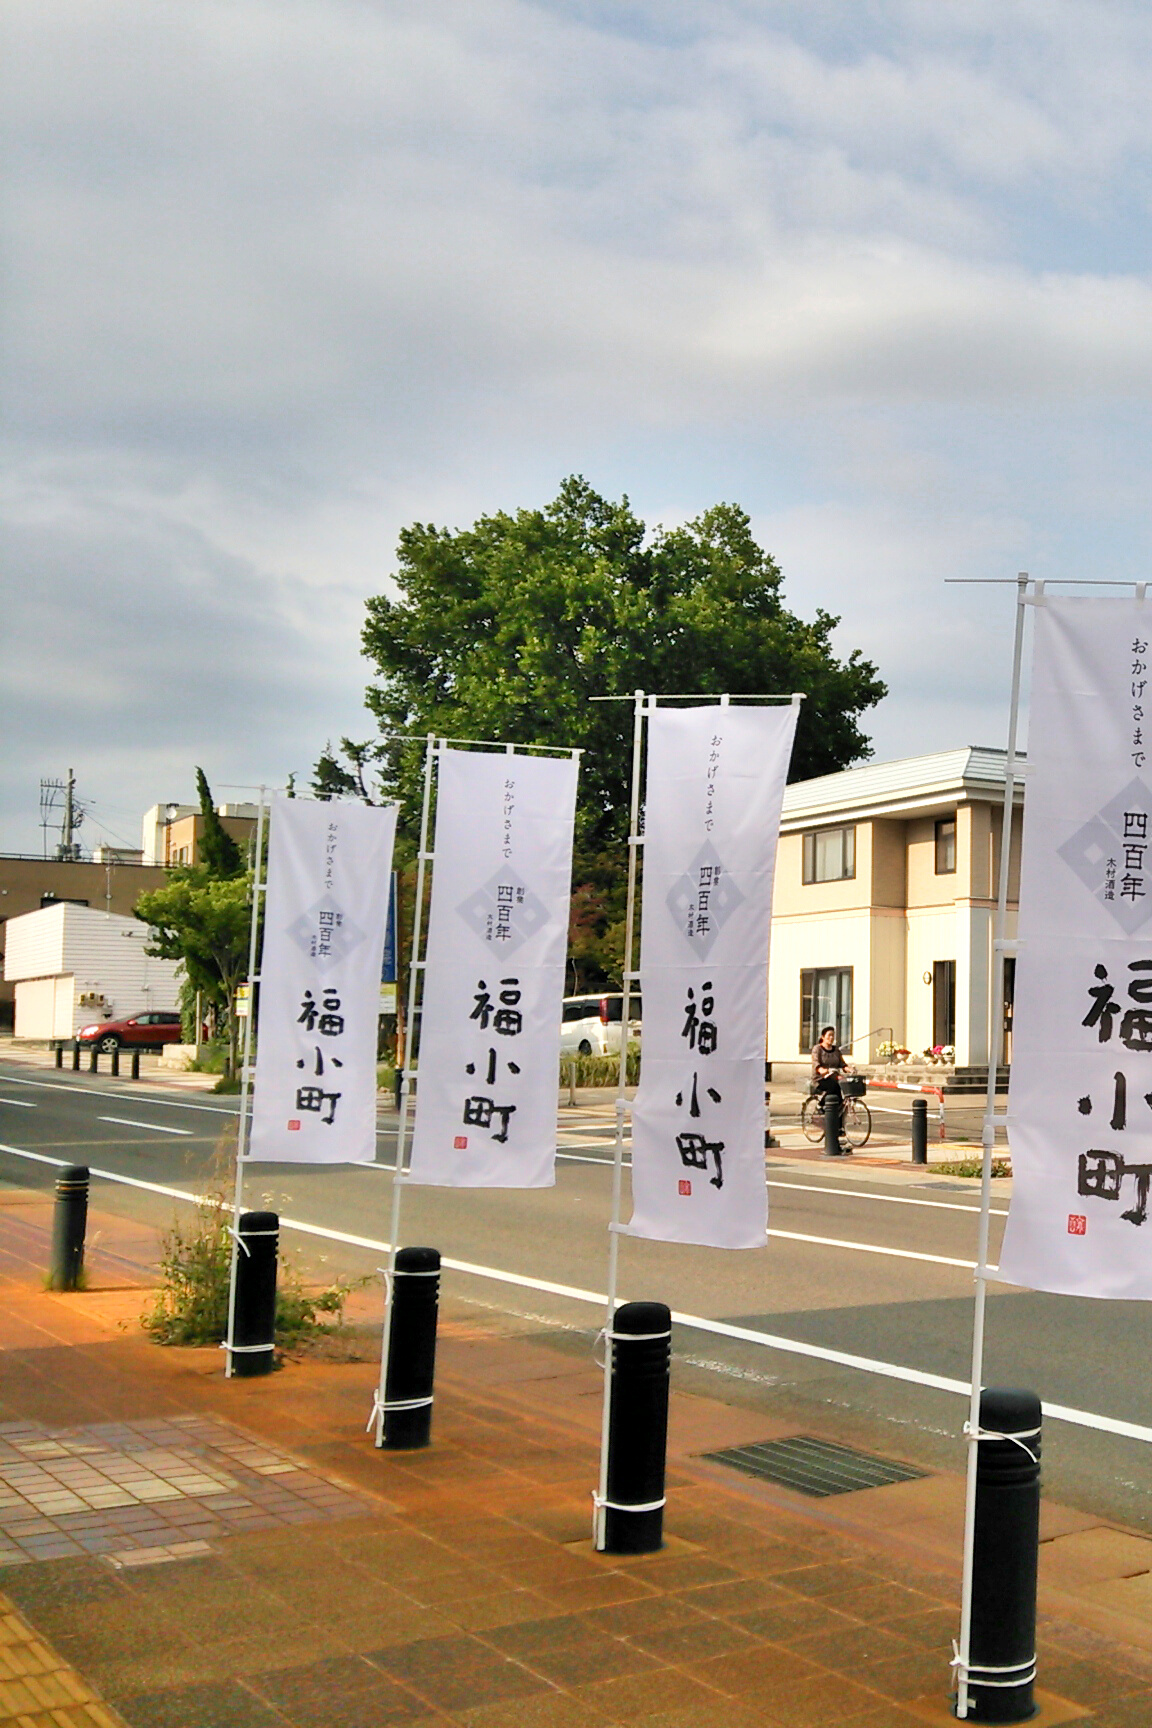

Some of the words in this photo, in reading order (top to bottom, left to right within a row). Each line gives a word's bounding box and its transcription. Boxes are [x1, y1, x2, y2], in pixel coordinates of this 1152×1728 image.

[1130, 637, 1149, 768] おかげさまで
[502, 778, 515, 858] おかげさまで
[704, 734, 723, 832] おかげさまで
[696, 866, 713, 936] 四百年
[1104, 857, 1117, 900] 木村酒造
[1120, 811, 1148, 901] 四百年
[495, 885, 513, 941] 四百年
[296, 988, 345, 1126] 福小町
[463, 978, 523, 1143] 福小町
[675, 981, 725, 1190] 福小町
